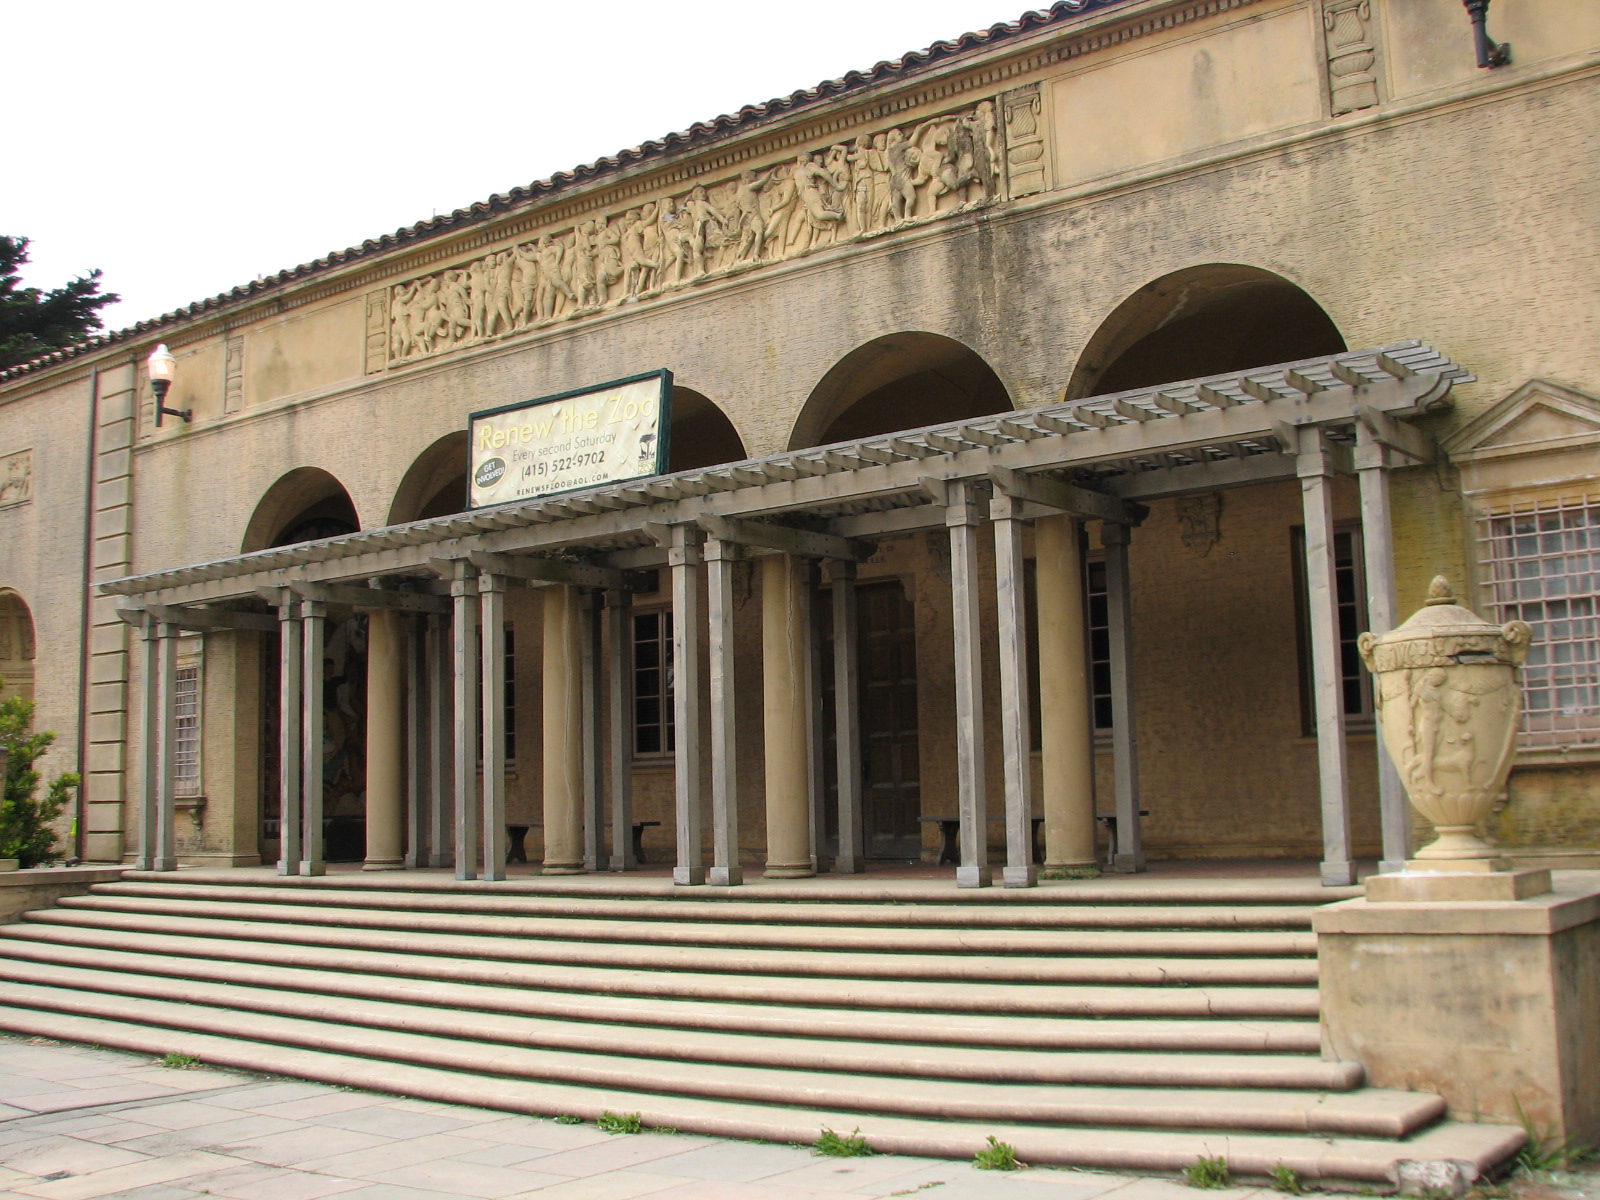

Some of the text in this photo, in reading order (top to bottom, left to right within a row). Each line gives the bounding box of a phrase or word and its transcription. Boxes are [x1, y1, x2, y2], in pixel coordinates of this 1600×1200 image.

[480, 393, 655, 452] Renew the Zoo
[513, 431, 616, 462] Every second Saturday
[476, 467, 505, 485] INVOLVED!
[483, 461, 496, 473] GET
[521, 450, 605, 481] (415) 522-9702
[516, 472, 609, 496] RENEWSFZOO@AOL.COM
